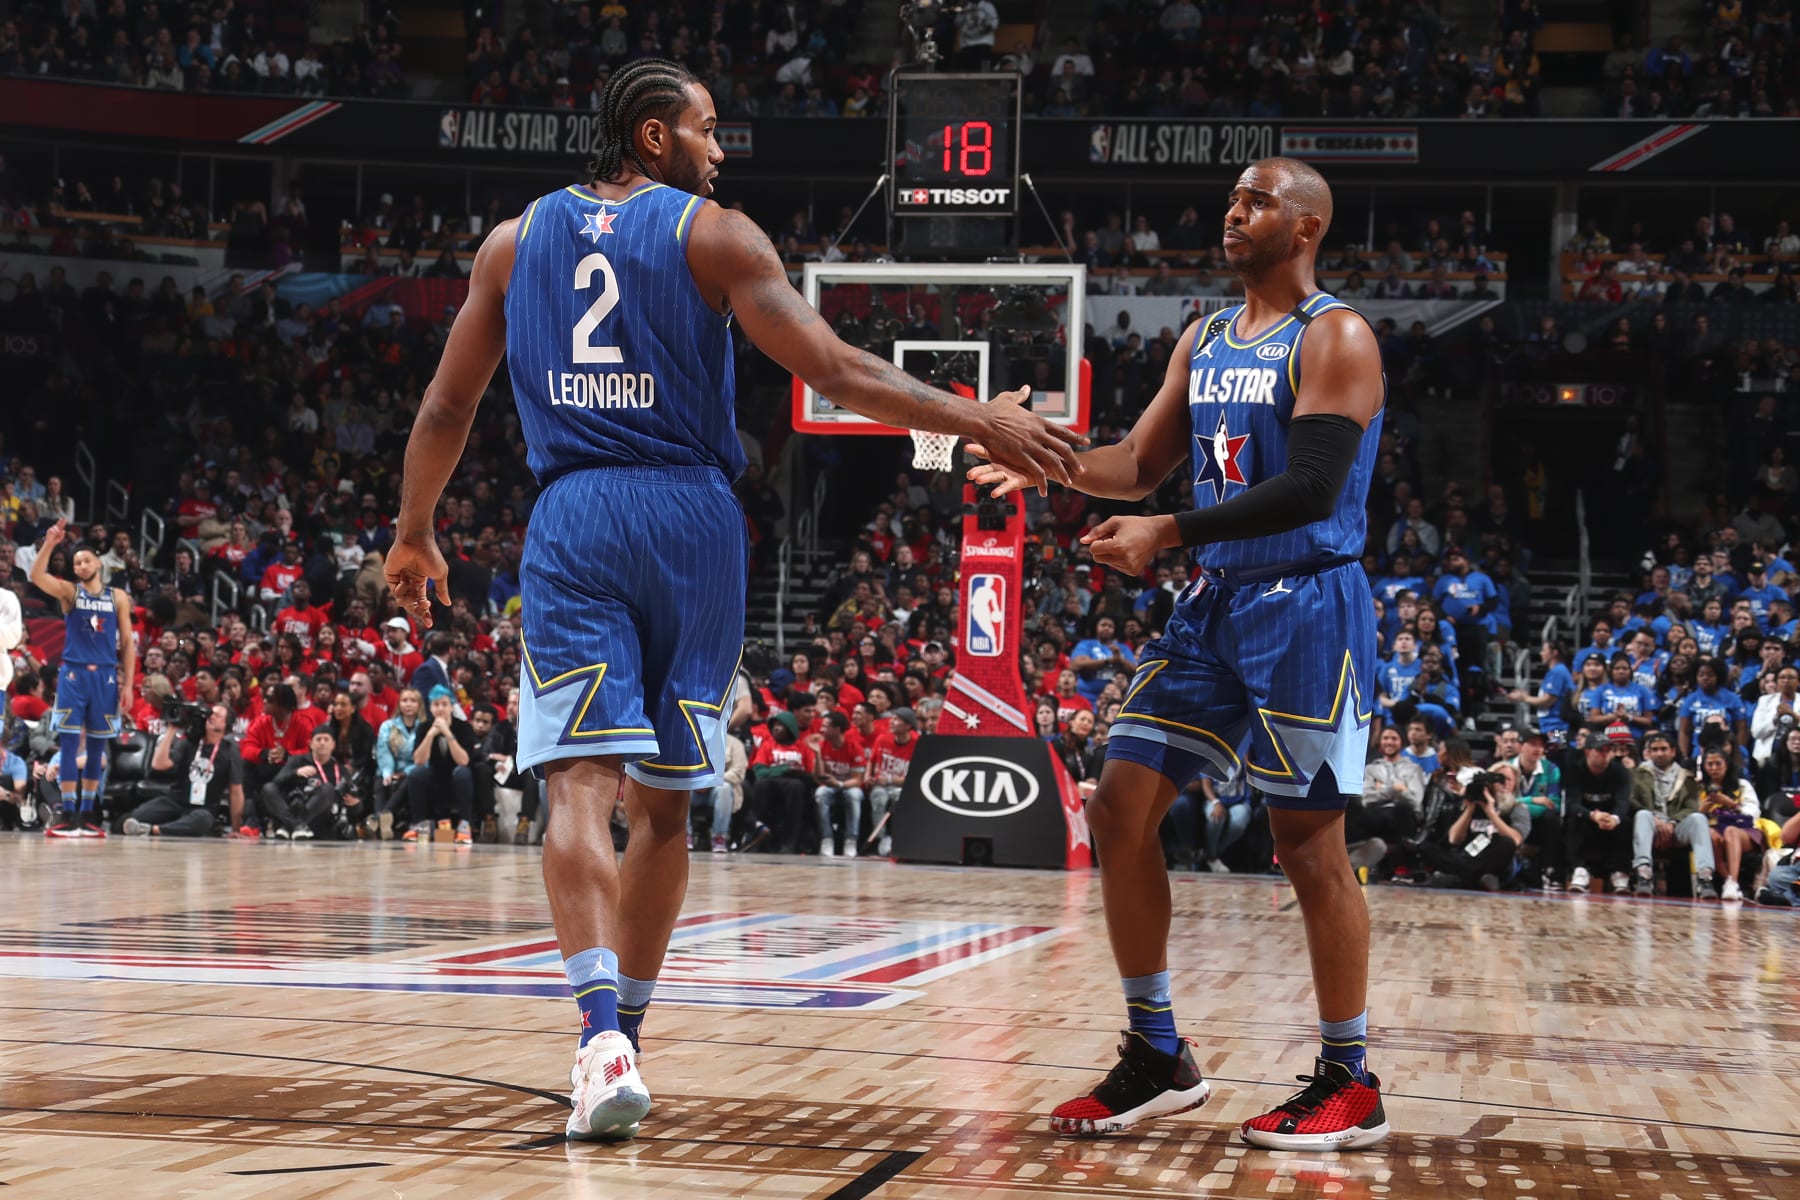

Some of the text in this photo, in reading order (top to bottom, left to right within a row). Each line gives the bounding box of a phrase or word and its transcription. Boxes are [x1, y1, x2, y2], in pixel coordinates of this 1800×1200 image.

[565, 115, 604, 155] 202
[943, 121, 992, 176] 18
[1219, 124, 1274, 164] 2020
[1315, 137, 1385, 150] CHICAGO
[929, 189, 1010, 204] TISSOT
[572, 252, 624, 364] 2
[1260, 345, 1284, 357] KIA
[547, 370, 655, 409] LEONARD
[966, 545, 1015, 558] SPALDING
[941, 769, 1019, 805] KIA
